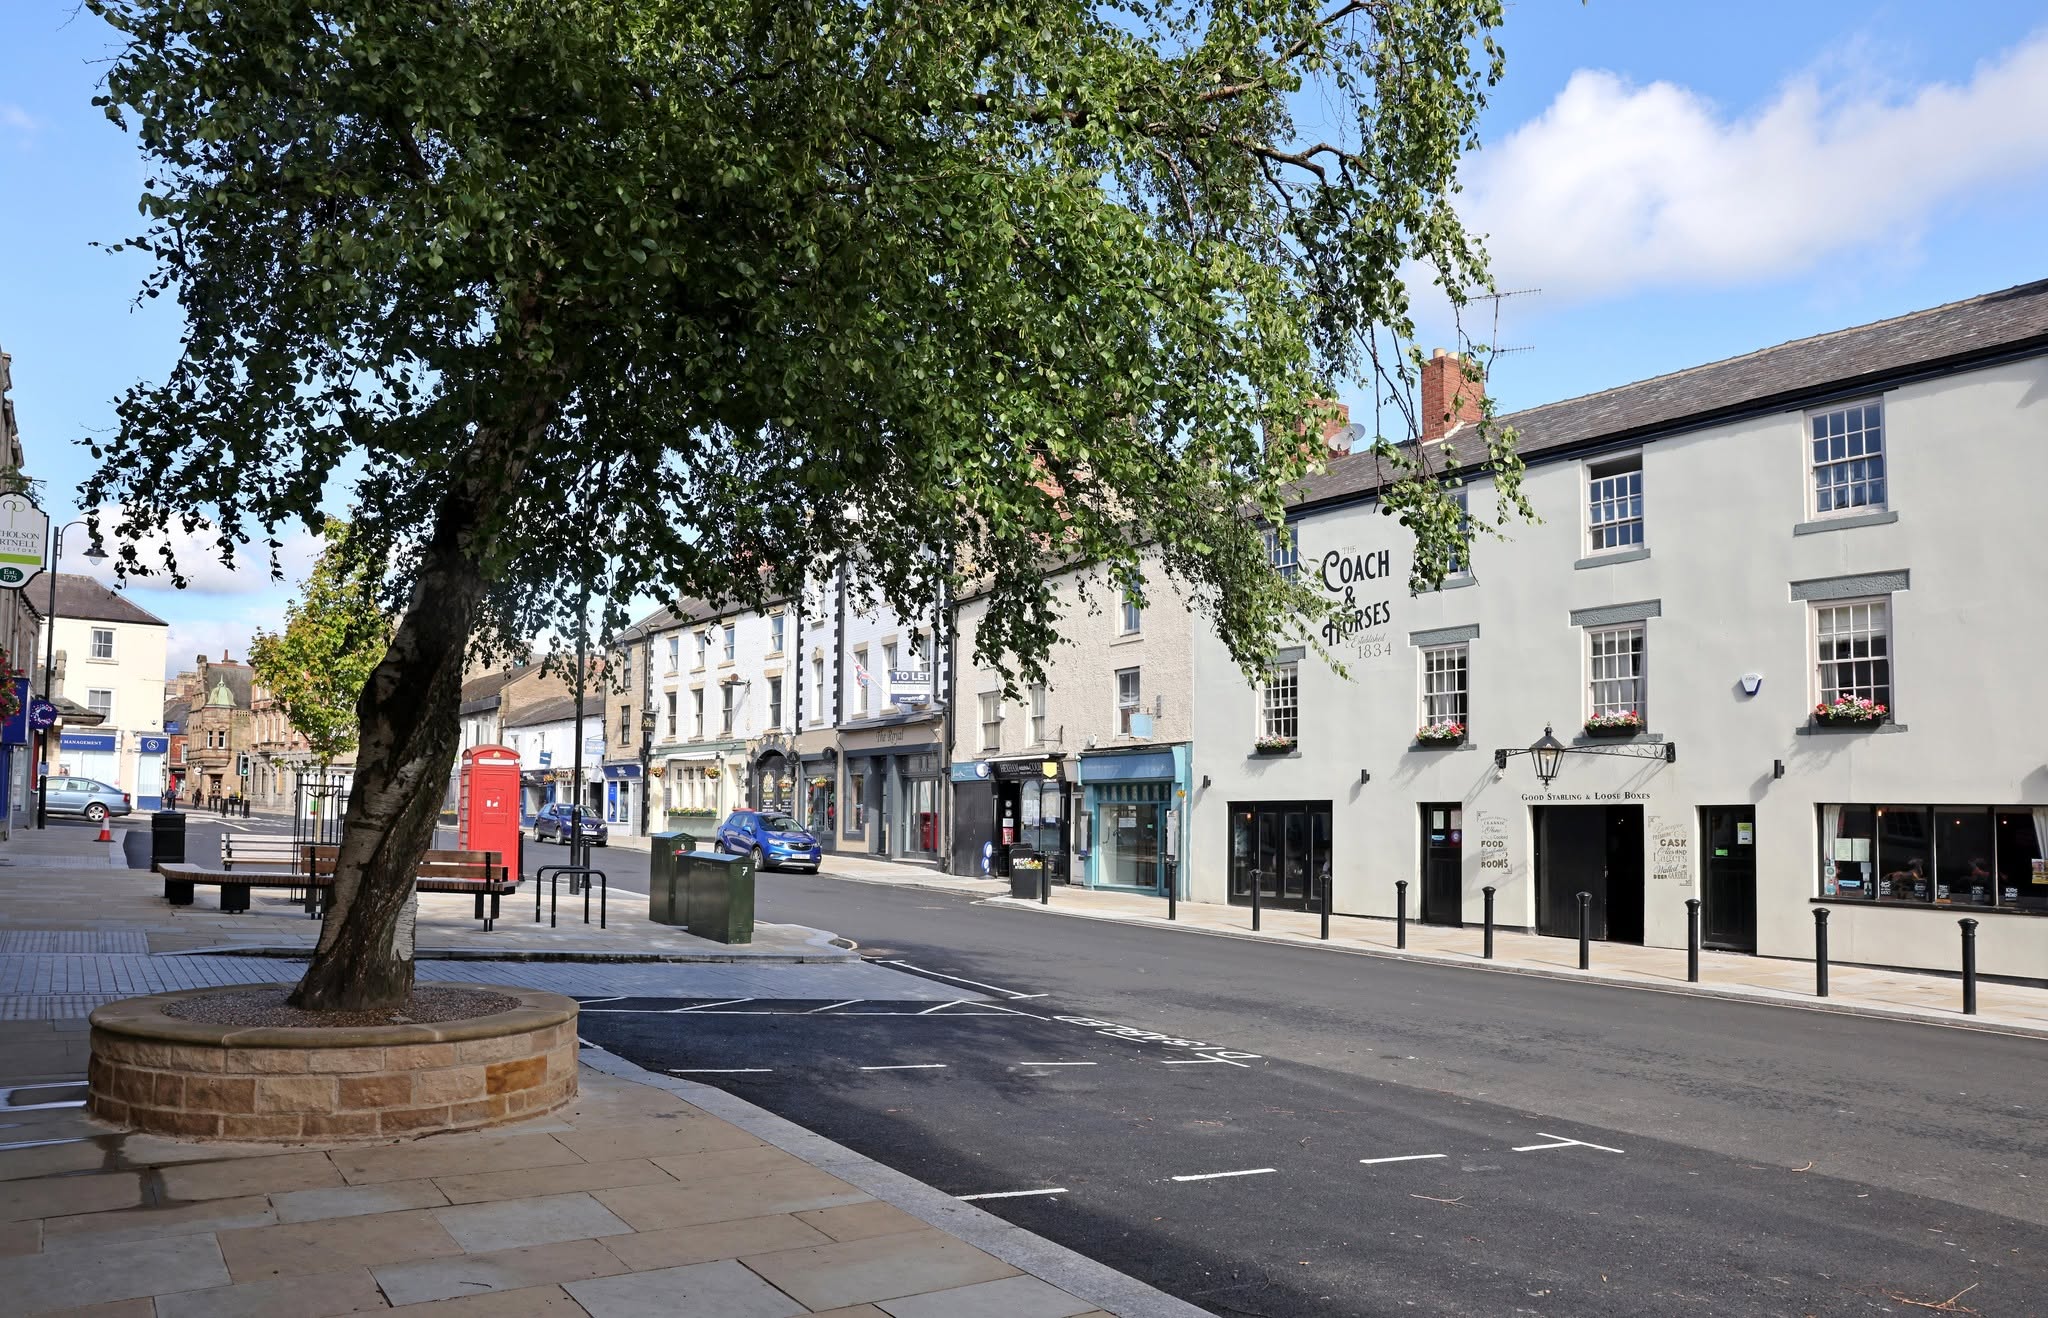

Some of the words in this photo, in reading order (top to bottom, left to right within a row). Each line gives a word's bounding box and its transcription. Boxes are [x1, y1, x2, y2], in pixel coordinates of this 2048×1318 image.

[0, 530, 40, 540] HOLSON
[1322, 549, 1390, 593] COACH
[1344, 585, 1357, 609] &
[1358, 642, 1392, 660] 1834
[894, 671, 910, 681] TO
[911, 671, 930, 681] LET
[1521, 793, 1544, 801] GOOD
[1547, 792, 1582, 801] STABLING
[1594, 792, 1621, 800] LOOSE
[1624, 791, 1651, 800] BOXES
[1481, 840, 1504, 848] FOOD
[1660, 839, 1687, 848] CASK
[1481, 858, 1509, 868] ROOMS
[1053, 1015, 1262, 1059] DISABLED
